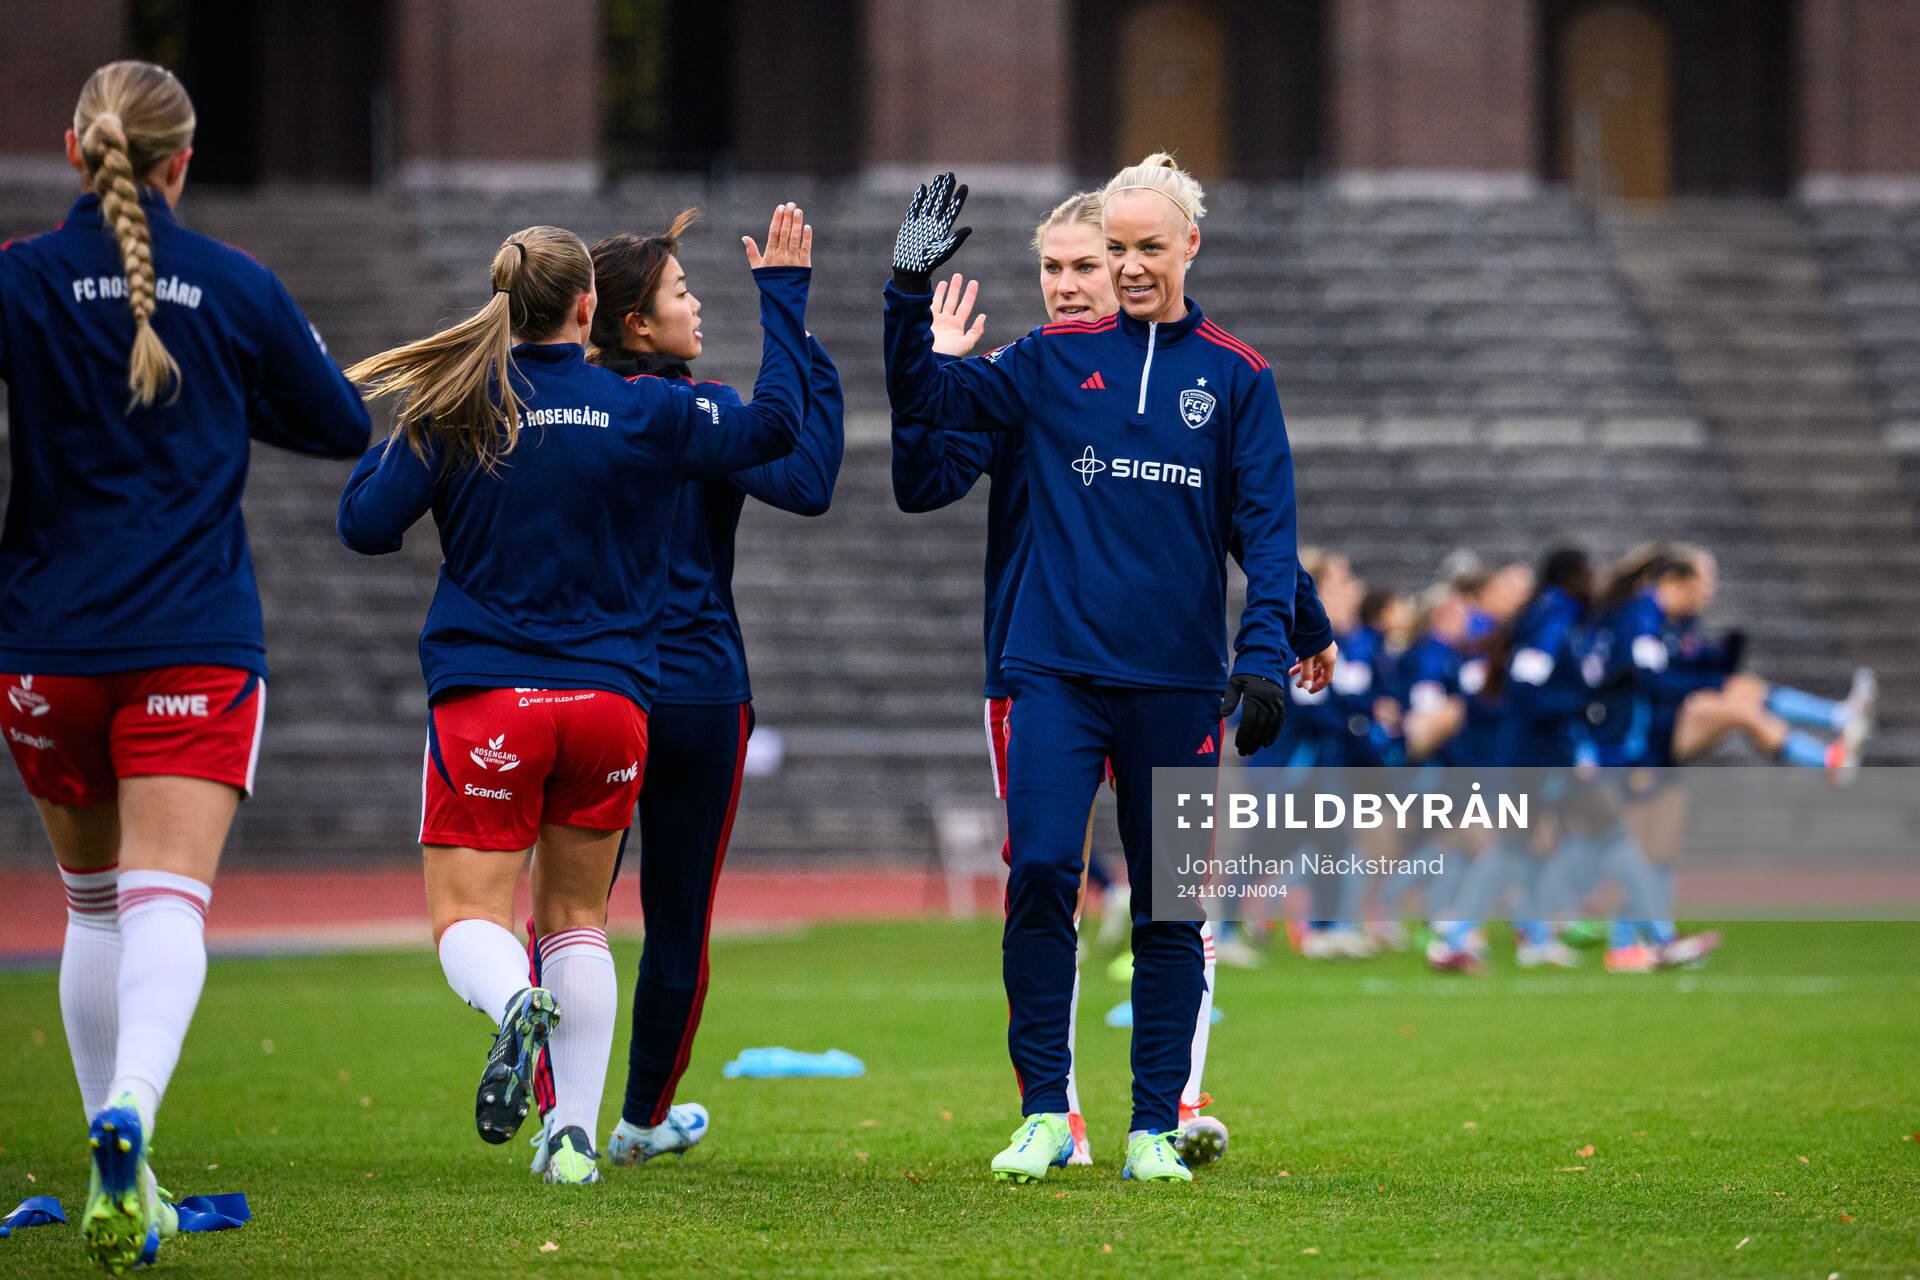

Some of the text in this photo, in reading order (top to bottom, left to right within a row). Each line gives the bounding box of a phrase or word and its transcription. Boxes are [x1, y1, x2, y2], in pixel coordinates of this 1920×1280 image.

[72, 275, 202, 309] FC ROSGÅRD
[525, 405, 610, 428] ROSENGÅRD
[1184, 398, 1209, 412] FCR
[146, 694, 208, 717] RWE
[574, 692, 595, 701] GROUP
[9, 726, 56, 751] Scandic
[474, 746, 517, 762] ROSENGÅRD
[606, 760, 638, 784] RWE
[464, 783, 512, 801] Scandic
